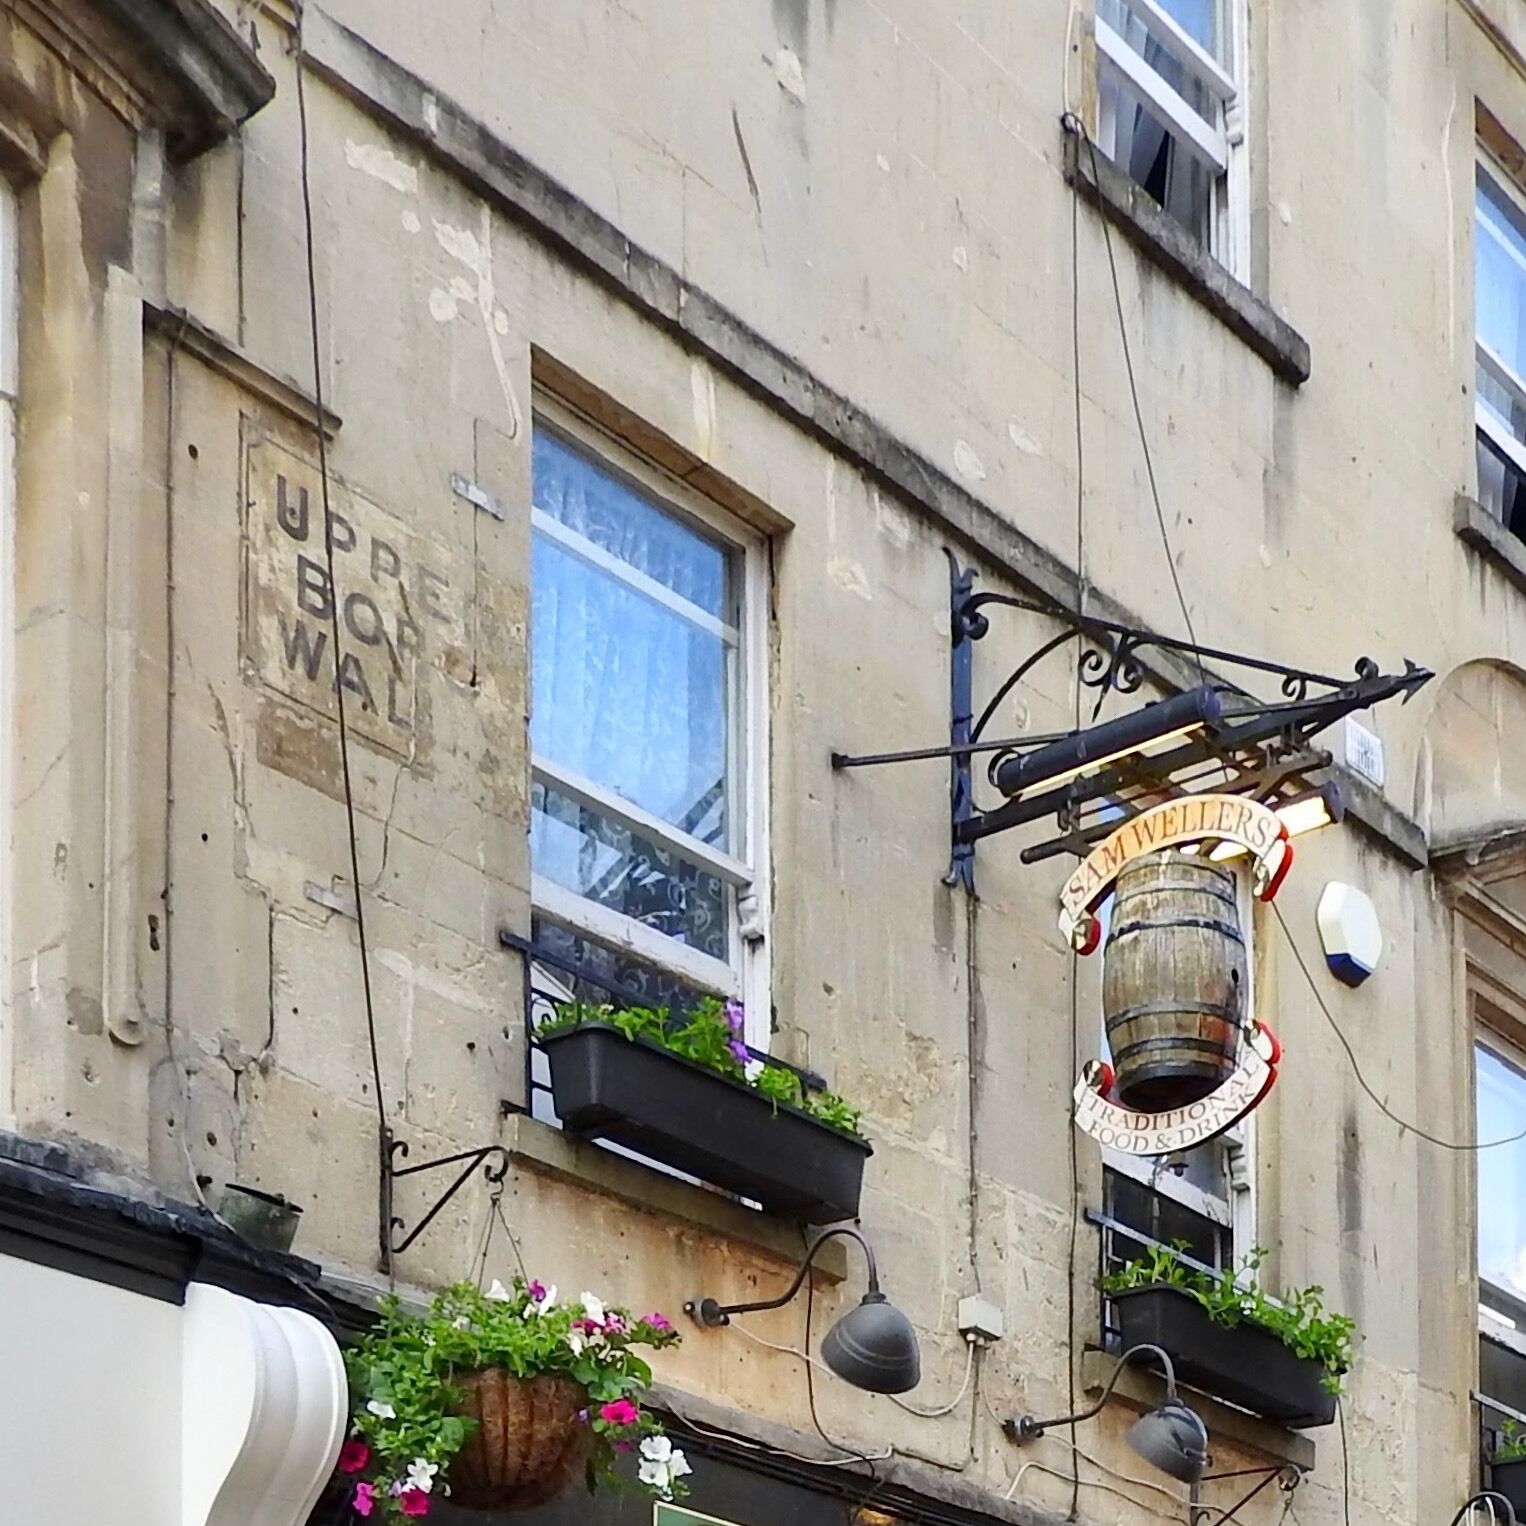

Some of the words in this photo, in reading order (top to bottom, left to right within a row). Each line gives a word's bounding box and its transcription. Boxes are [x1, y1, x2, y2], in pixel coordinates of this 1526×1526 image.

[1068, 841, 1127, 895] SAM
[1129, 801, 1274, 850] WELLERS
[1087, 1056, 1261, 1131] TRADITIONAL
[1088, 1118, 1149, 1154] FOOD
[1155, 1134, 1175, 1151] &
[1178, 1088, 1256, 1145] DRINK
